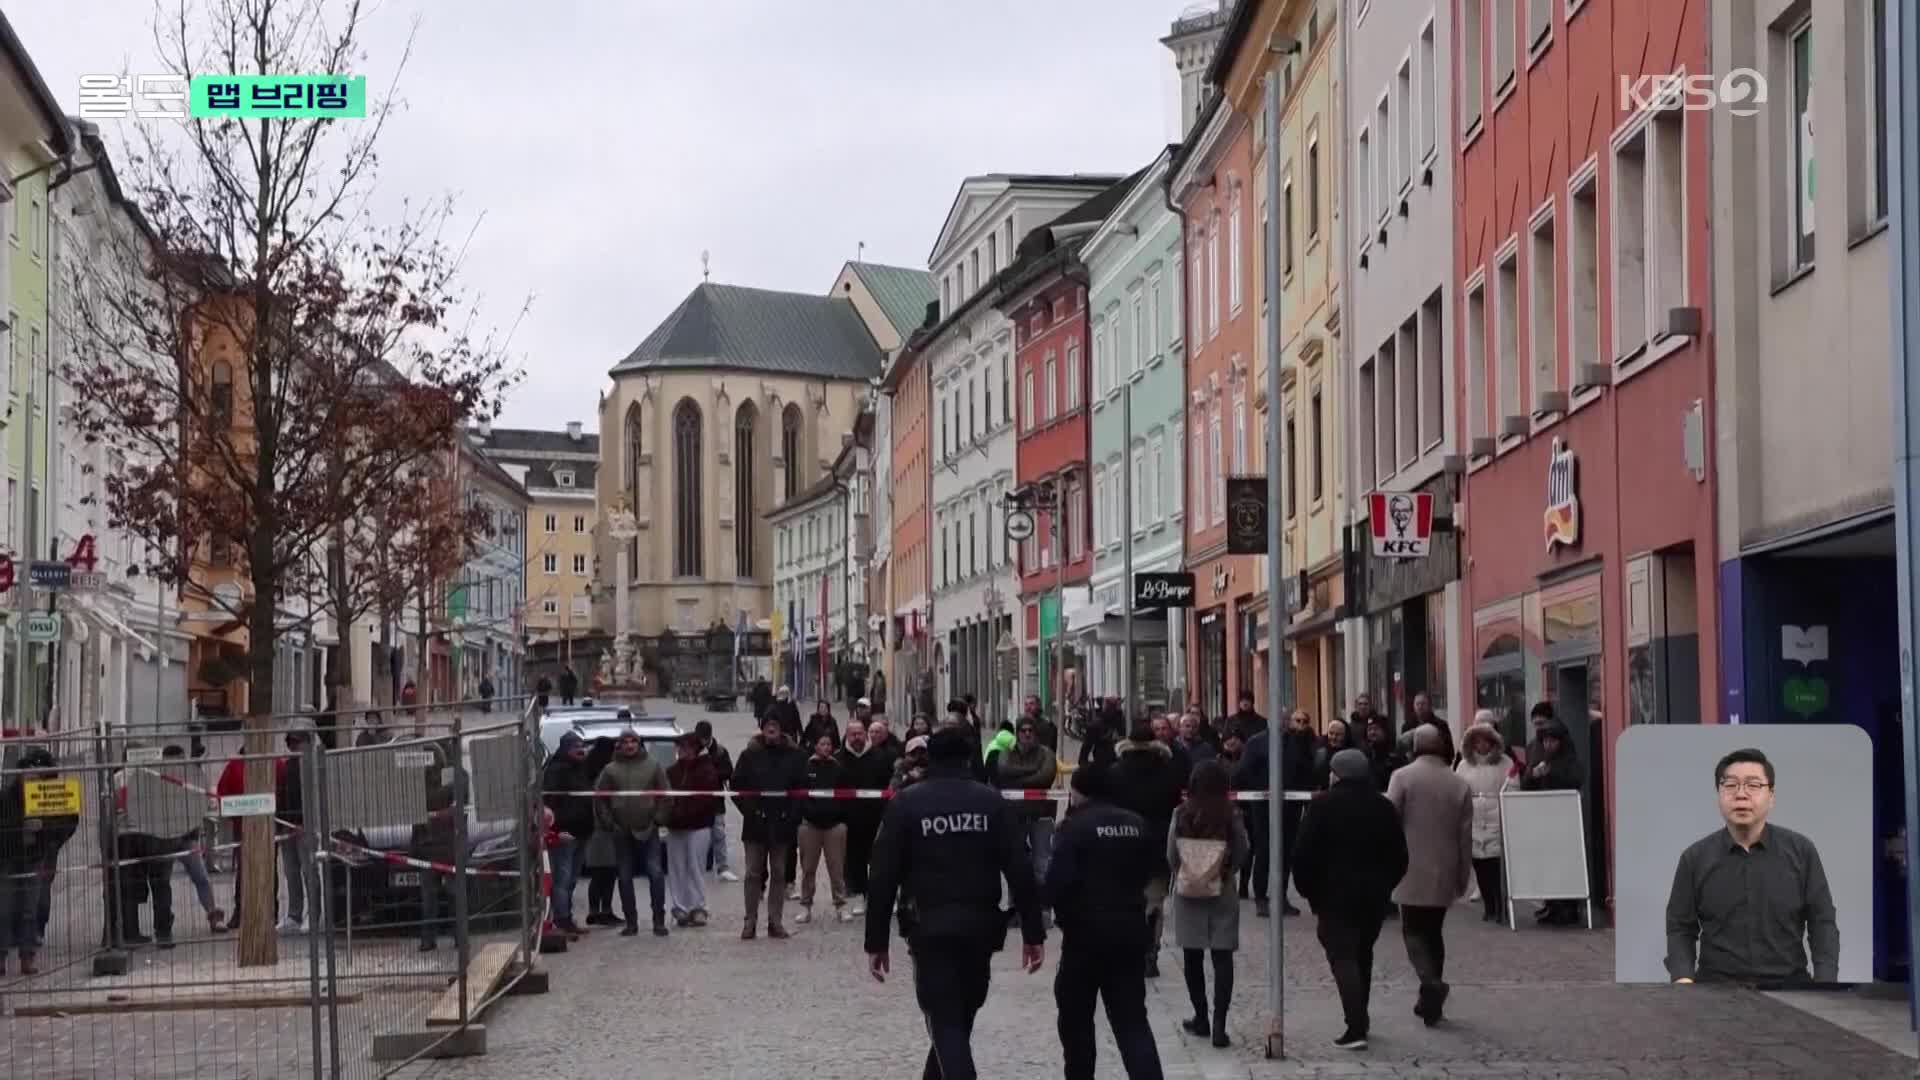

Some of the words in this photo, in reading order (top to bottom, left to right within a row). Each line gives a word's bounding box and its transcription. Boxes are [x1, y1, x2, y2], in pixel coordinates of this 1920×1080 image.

[1382, 540, 1422, 554] KFC
[1155, 579, 1192, 600] Burger
[921, 813, 988, 836] POLIZEI
[1096, 824, 1139, 838] POLIZEI
